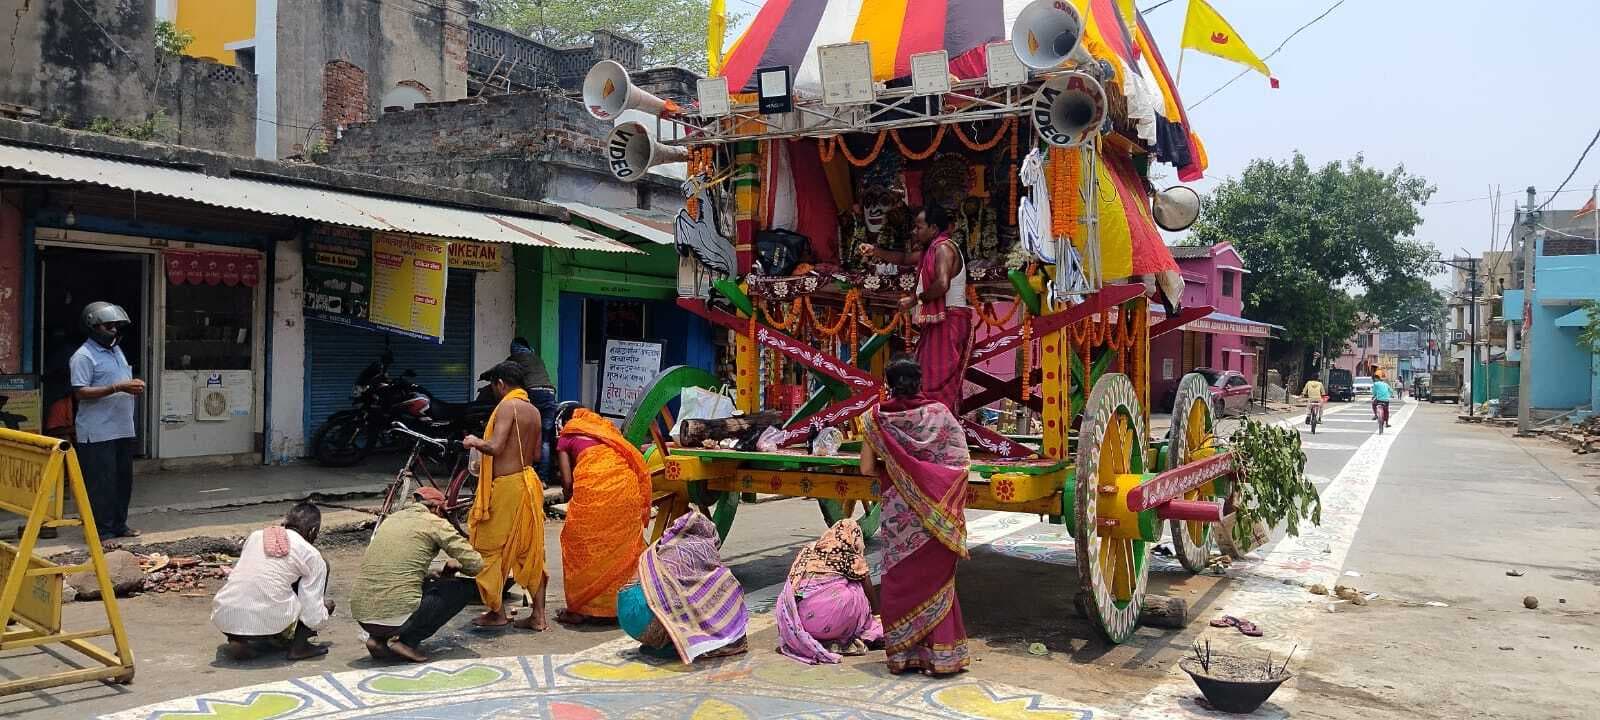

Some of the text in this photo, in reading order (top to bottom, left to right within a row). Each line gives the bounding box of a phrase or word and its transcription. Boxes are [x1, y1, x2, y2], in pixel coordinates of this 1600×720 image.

[1035, 87, 1071, 144] VIDEO
[609, 129, 634, 178] VIDEO
[448, 242, 496, 260] NIKETAN
